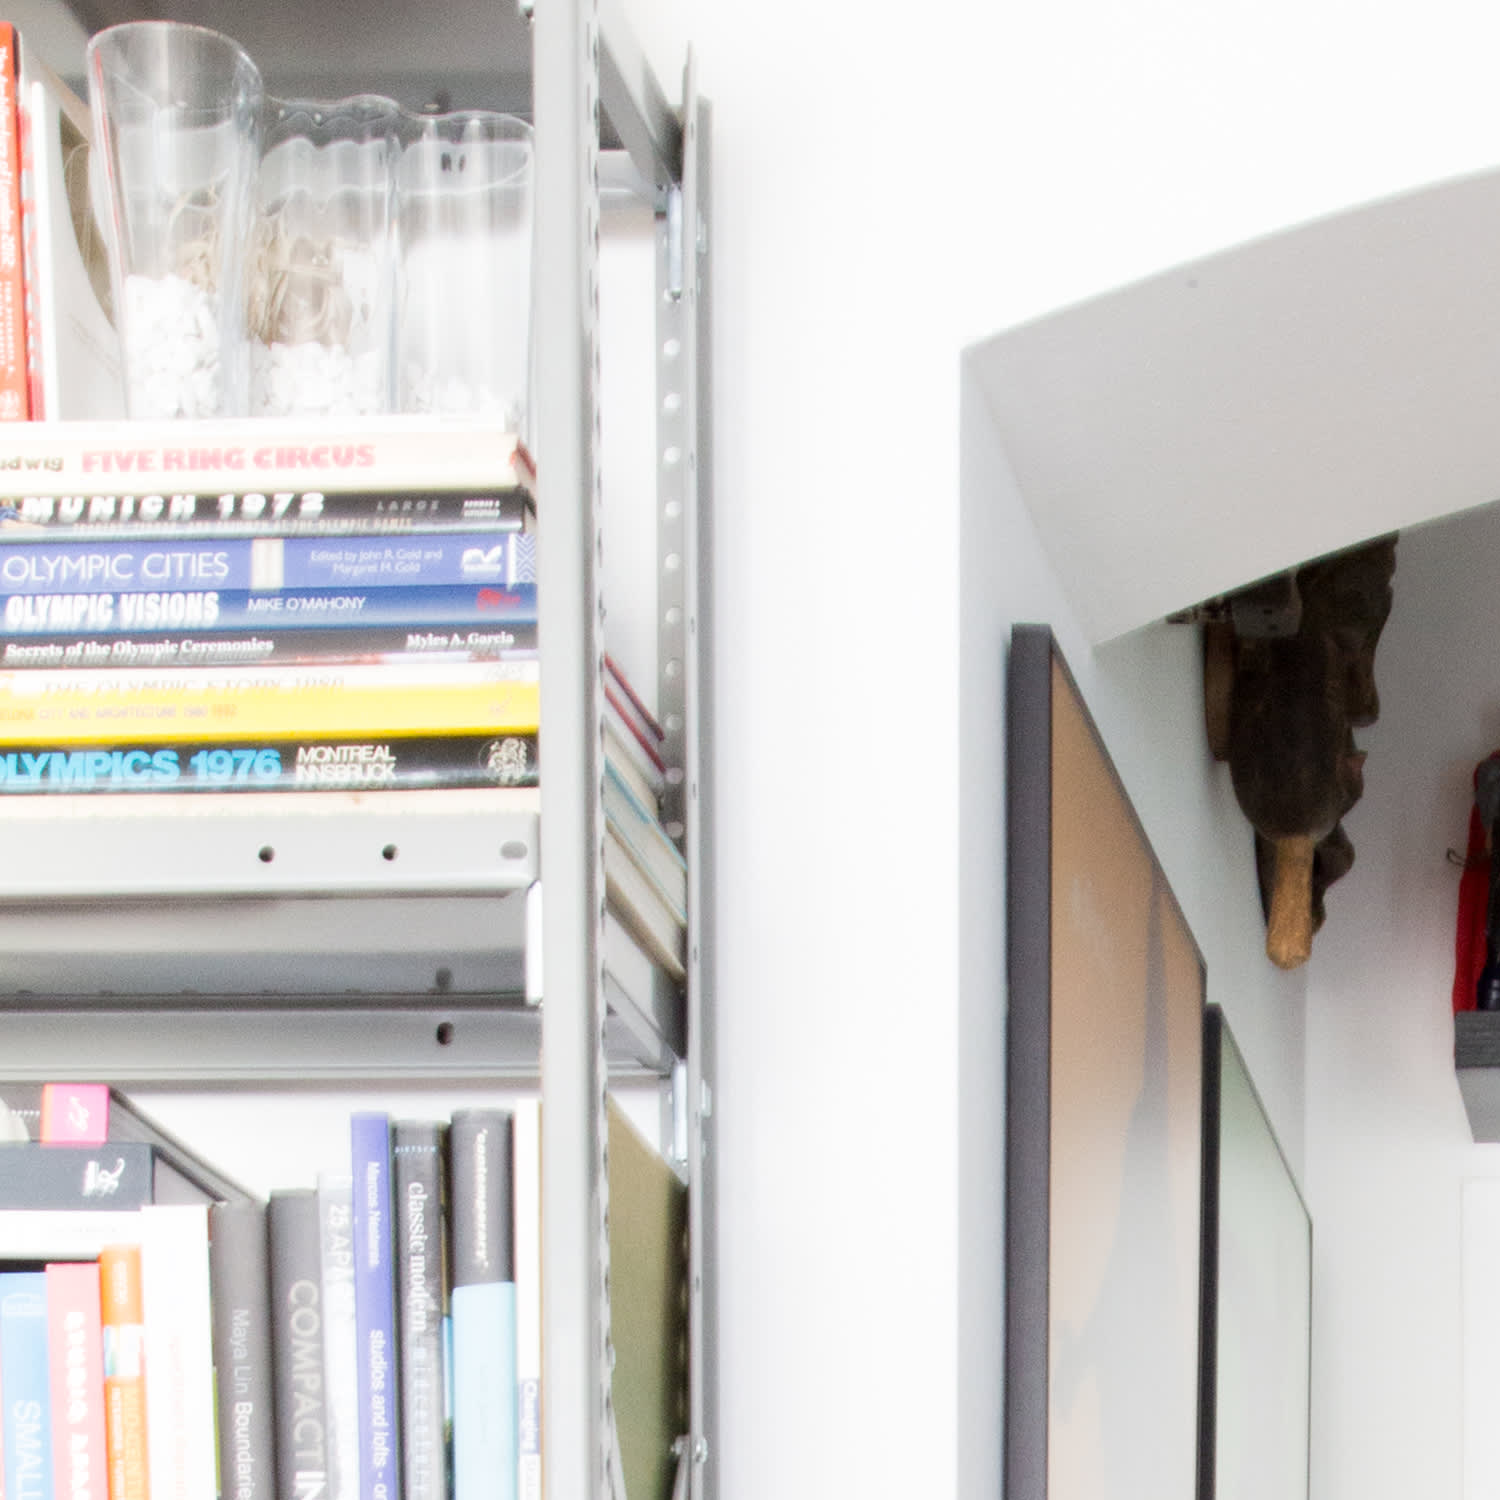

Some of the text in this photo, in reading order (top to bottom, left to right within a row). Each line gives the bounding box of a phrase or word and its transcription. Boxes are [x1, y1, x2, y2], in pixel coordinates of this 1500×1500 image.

[82, 450, 156, 473] FIVE
[162, 448, 244, 472] RING
[253, 444, 376, 470] CIRCUS
[20, 493, 325, 522] MUNICH 1972
[3, 551, 231, 582] OLYMPIC CITIES
[6, 592, 220, 631] OLYMPIC VISIONS
[248, 597, 283, 611] MIKE
[6, 637, 274, 659] Secrets of the Olympic Ceremonies
[406, 633, 449, 650] Myles
[468, 632, 515, 647] Garcia
[191, 748, 281, 783] 1976
[298, 745, 397, 764] MONTREAL
[296, 764, 397, 782] INNSBRUCK
[408, 1182, 429, 1253] classic
[408, 1255, 431, 1332] modern
[230, 1309, 250, 1359] Maya
[289, 1279, 326, 1466] COMPACT
[369, 1328, 389, 1391] studios
[233, 1365, 252, 1394] Lin
[370, 1394, 390, 1427] and
[372, 1431, 391, 1469] lofts
